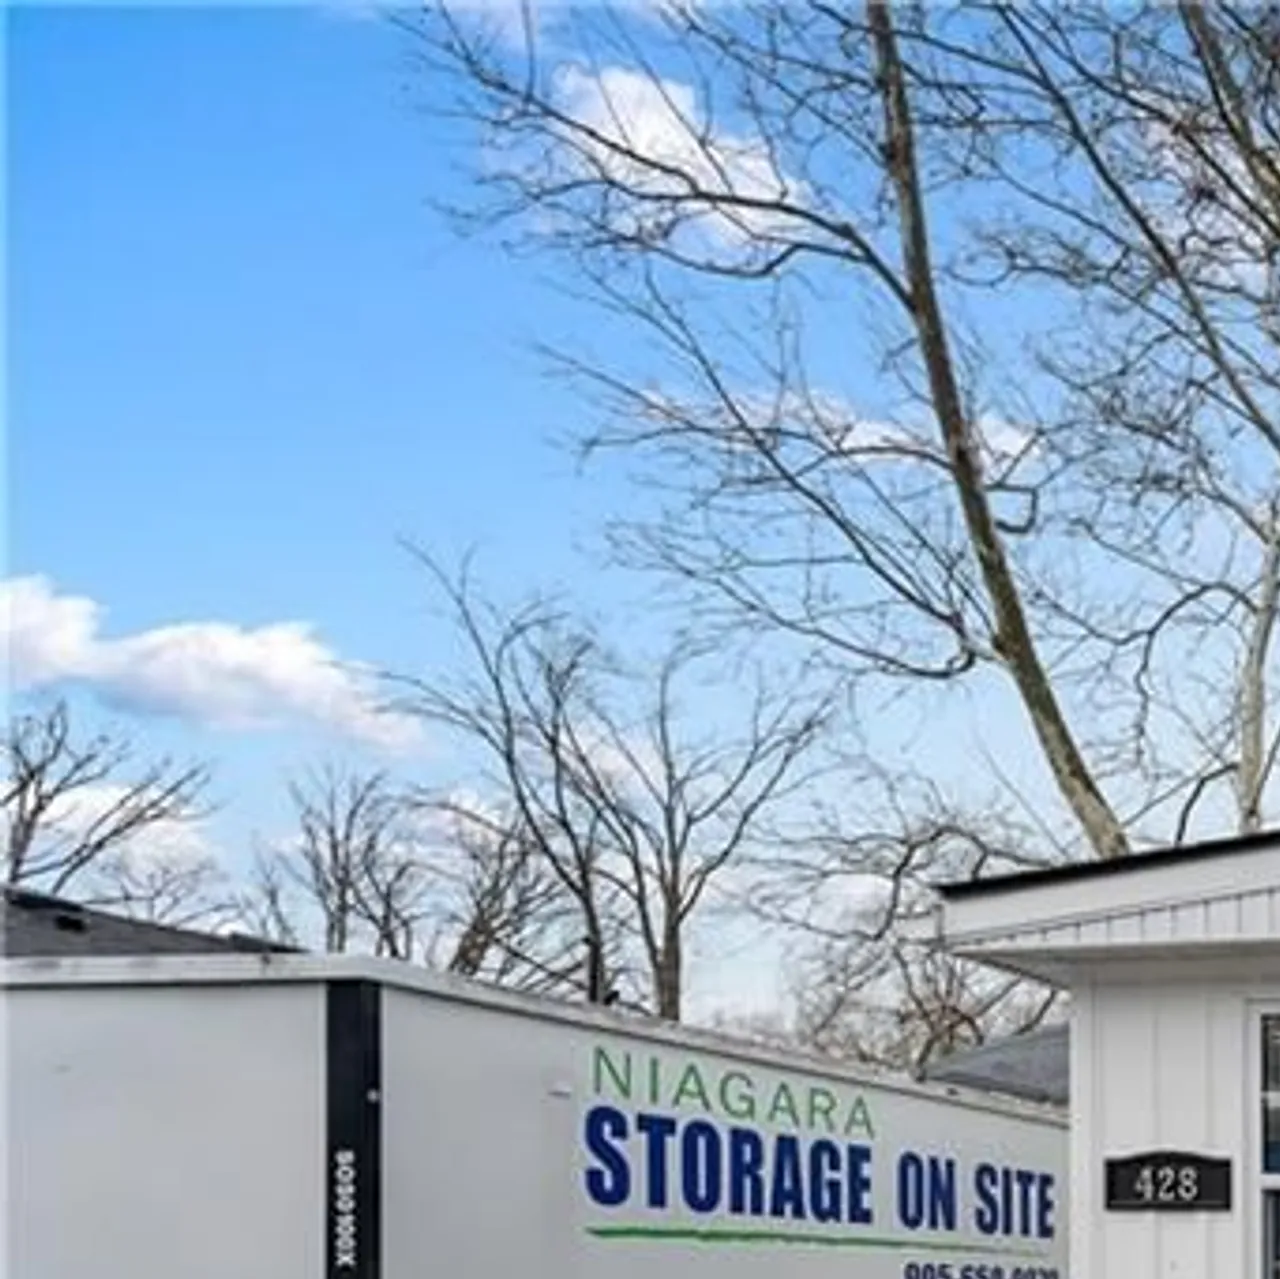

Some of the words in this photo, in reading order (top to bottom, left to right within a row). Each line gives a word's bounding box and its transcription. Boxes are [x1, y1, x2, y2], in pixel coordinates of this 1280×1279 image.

[593, 1046, 876, 1139] NIAGARA
[585, 1106, 873, 1225] STORAGE
[899, 1151, 956, 1232] ON
[975, 1163, 1056, 1239] SITE
[1133, 1165, 1199, 1201] 428
